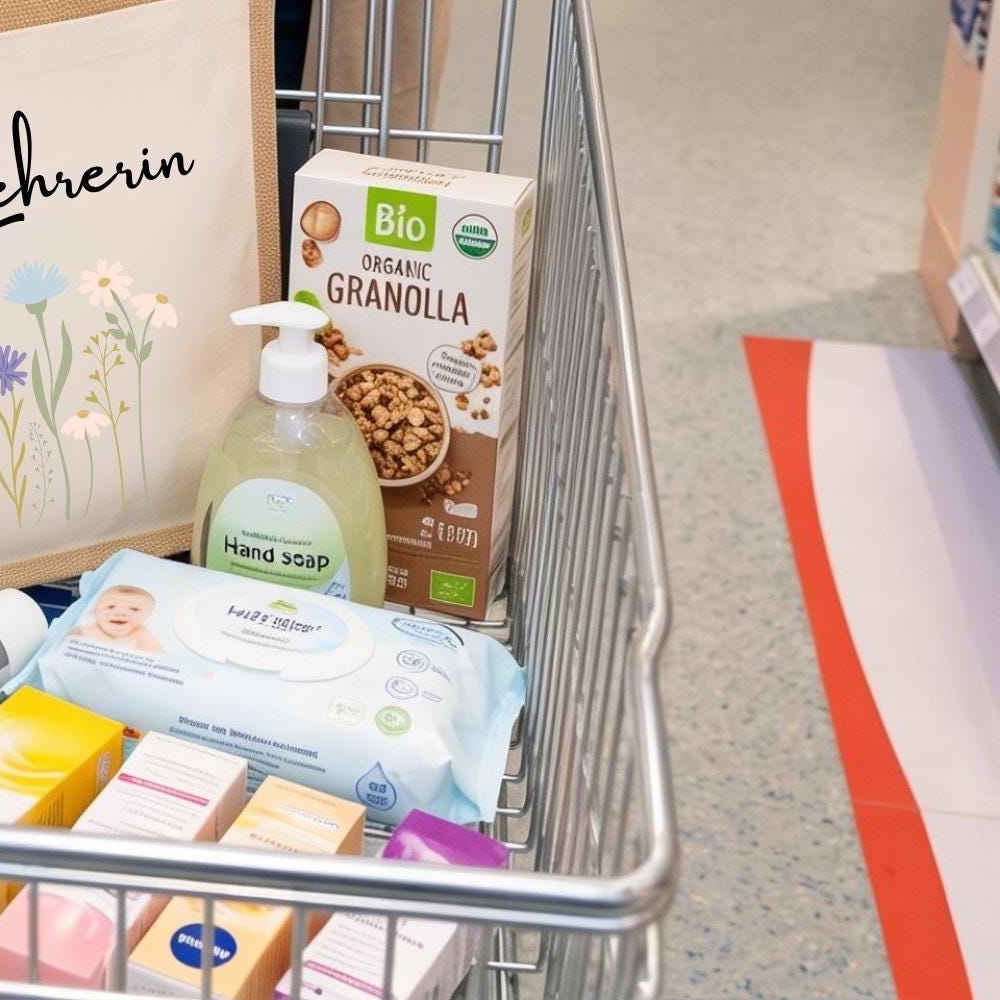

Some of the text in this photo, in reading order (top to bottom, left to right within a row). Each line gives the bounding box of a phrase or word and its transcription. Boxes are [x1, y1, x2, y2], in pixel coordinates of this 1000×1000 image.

[374, 203, 427, 242] Bio
[362, 253, 433, 282] ORGANIC
[326, 272, 470, 326] GRANOLLA
[223, 534, 275, 564] Hand
[281, 550, 331, 574] soap
